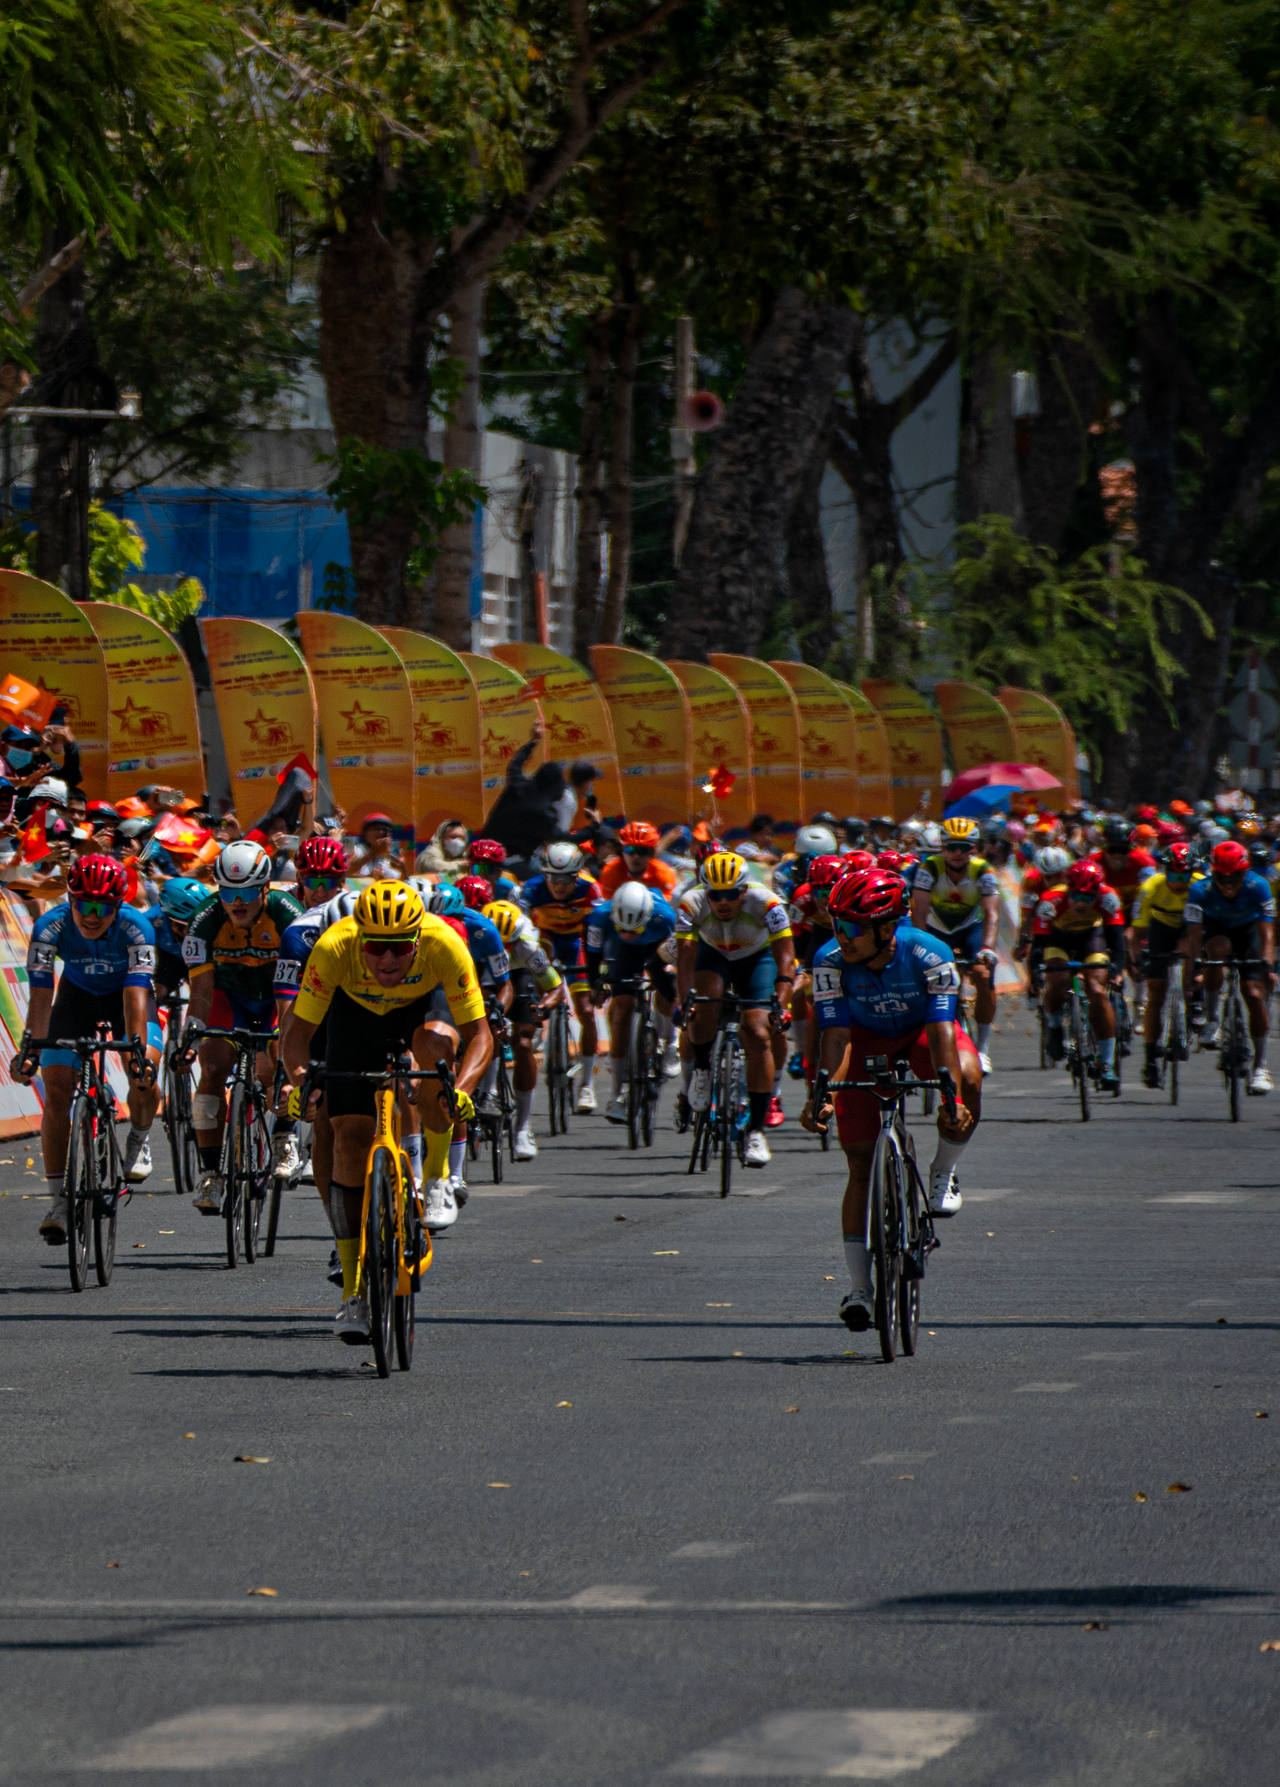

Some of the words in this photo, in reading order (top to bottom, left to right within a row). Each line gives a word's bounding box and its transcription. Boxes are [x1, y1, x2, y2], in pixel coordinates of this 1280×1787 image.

[34, 948, 52, 965] 14
[185, 941, 200, 956] 51
[912, 944, 927, 958] HO
[134, 950, 152, 966] 14
[276, 962, 295, 982] 37
[937, 968, 956, 986] 11
[815, 973, 835, 992] 11
[448, 995, 462, 1003] TON
